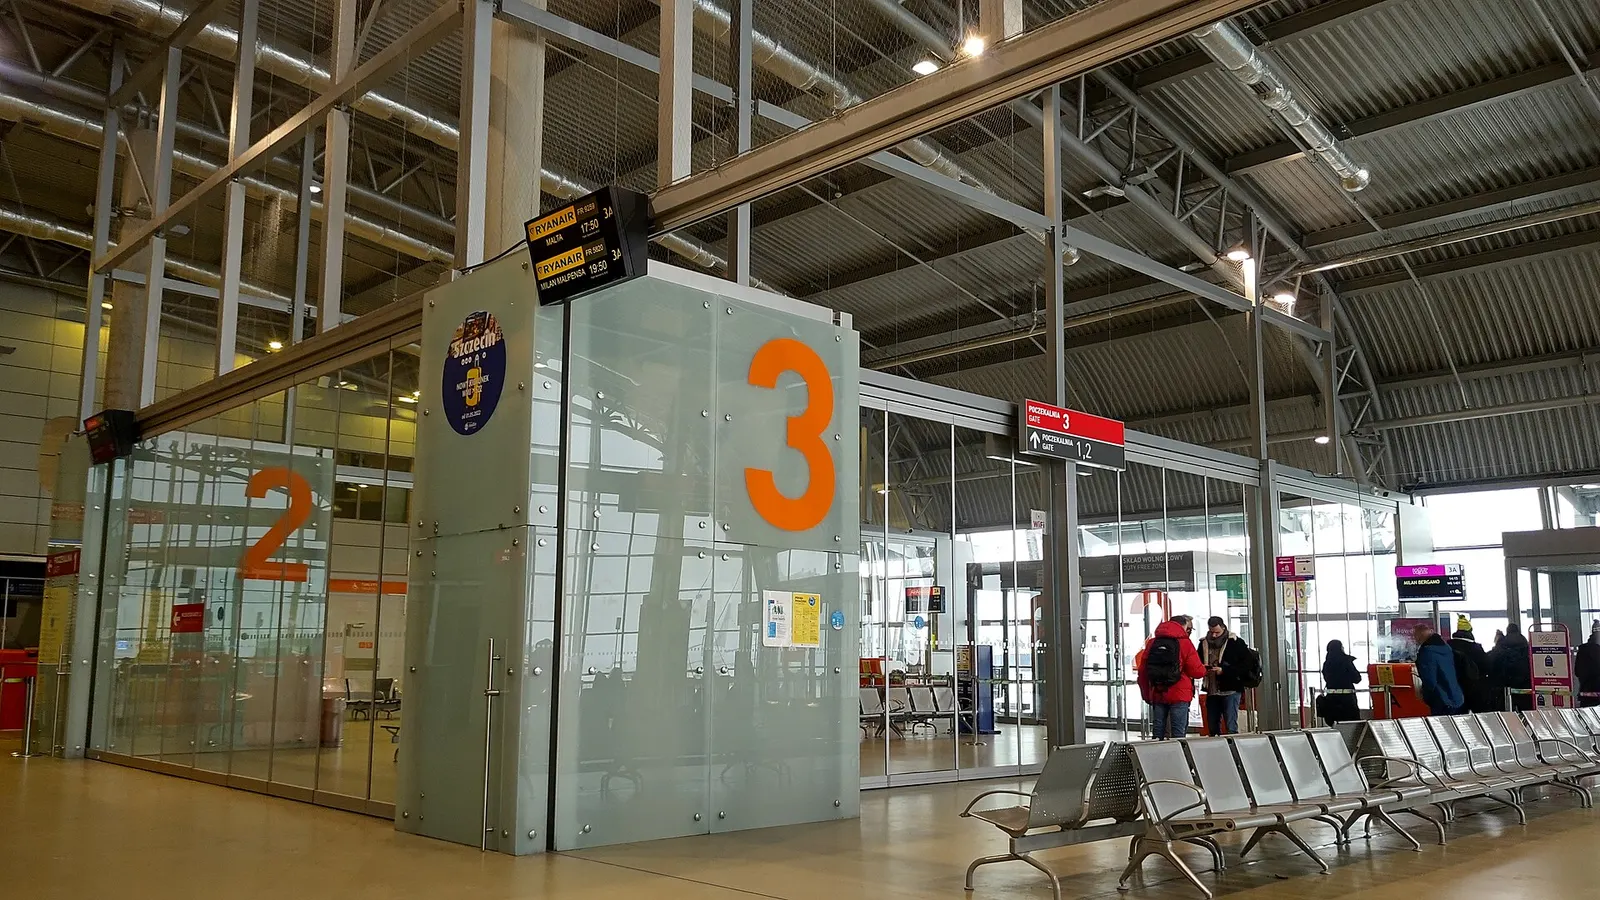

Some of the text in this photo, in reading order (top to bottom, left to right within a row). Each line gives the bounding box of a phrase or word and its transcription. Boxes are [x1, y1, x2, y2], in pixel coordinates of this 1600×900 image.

[577, 208, 585, 216] FR
[603, 206, 614, 219] 3A
[535, 211, 574, 235] RYANAIR
[580, 218, 599, 234] 17:50
[545, 234, 564, 246] MALTA
[585, 249, 593, 257] FR
[612, 248, 622, 261] 3A
[543, 252, 583, 275] RYANAIR
[589, 260, 608, 275] 19:50
[540, 278, 557, 291] MILAN
[556, 268, 586, 284] MALPENSA
[1028, 405, 1070, 430] POCZEKALNIA 3
[1028, 415, 1041, 424] GATE
[744, 338, 836, 532] 3
[1042, 433, 1092, 460] POCZEKALNIA 1,2
[1042, 443, 1055, 452] GATE
[241, 466, 313, 583] 2
